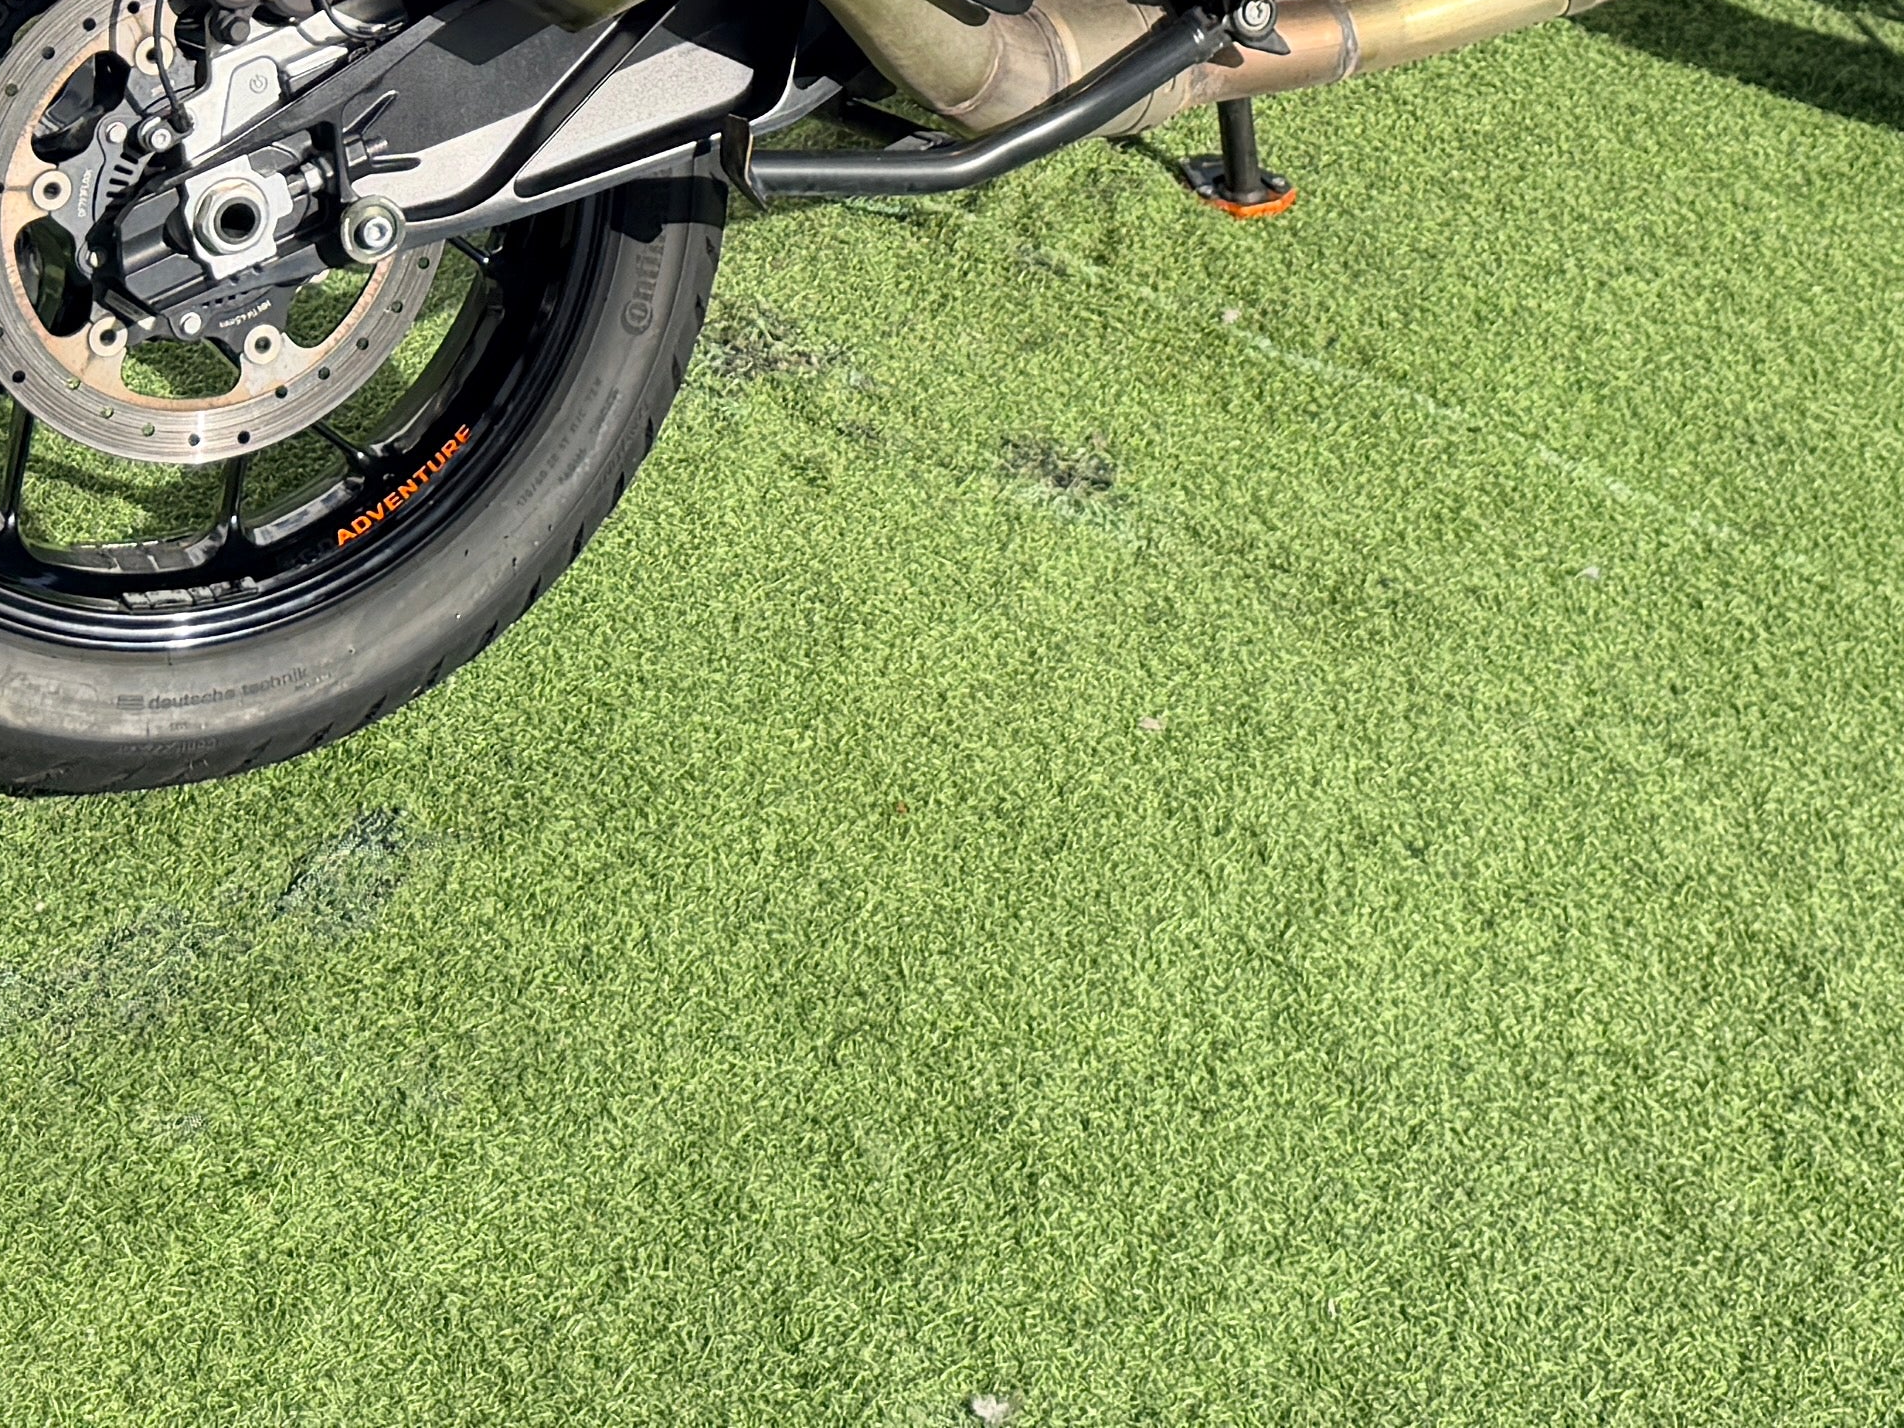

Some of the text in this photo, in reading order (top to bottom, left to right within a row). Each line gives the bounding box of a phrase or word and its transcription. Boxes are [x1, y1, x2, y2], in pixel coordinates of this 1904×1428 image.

[335, 423, 472, 547] ADVENTURE
[148, 687, 236, 711] deutsche
[241, 666, 309, 699] technik
